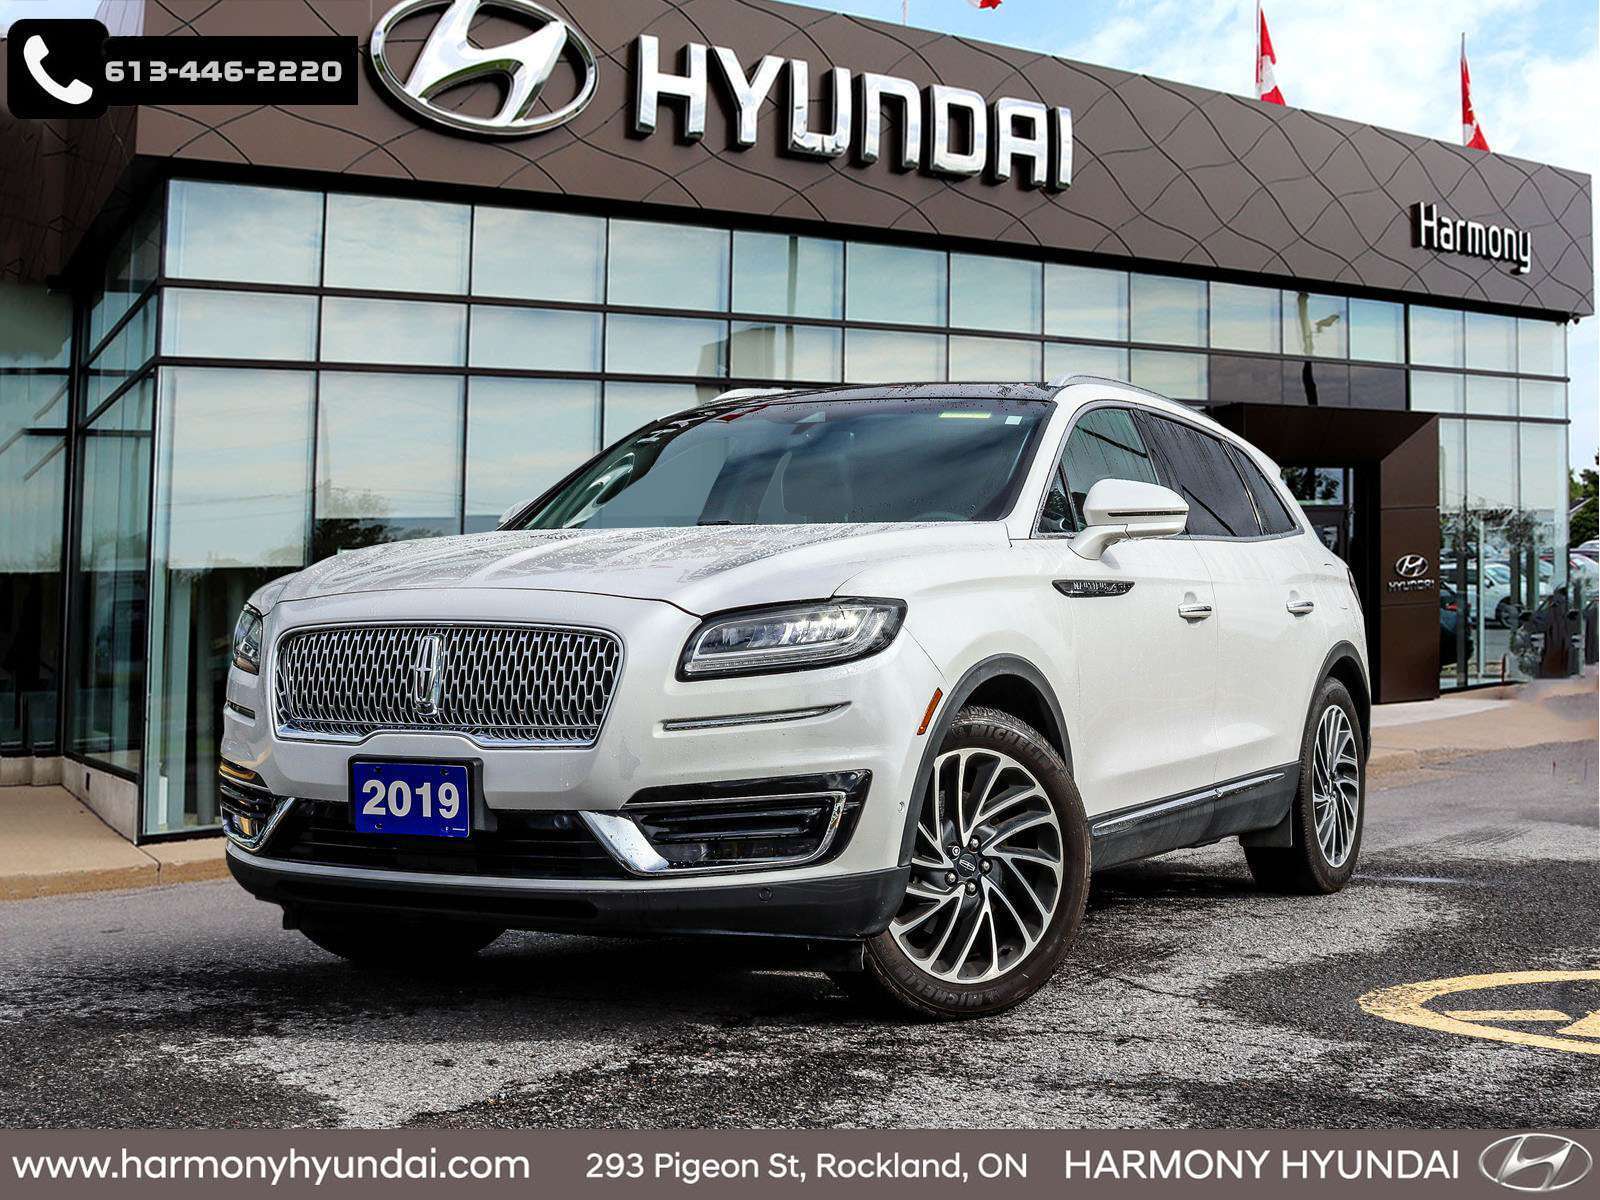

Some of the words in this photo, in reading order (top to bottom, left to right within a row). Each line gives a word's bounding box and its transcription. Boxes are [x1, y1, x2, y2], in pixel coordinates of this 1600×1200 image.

[635, 33, 1074, 192] HYUNDAI
[1419, 200, 1532, 274] Harmony
[362, 779, 460, 819] 2019
